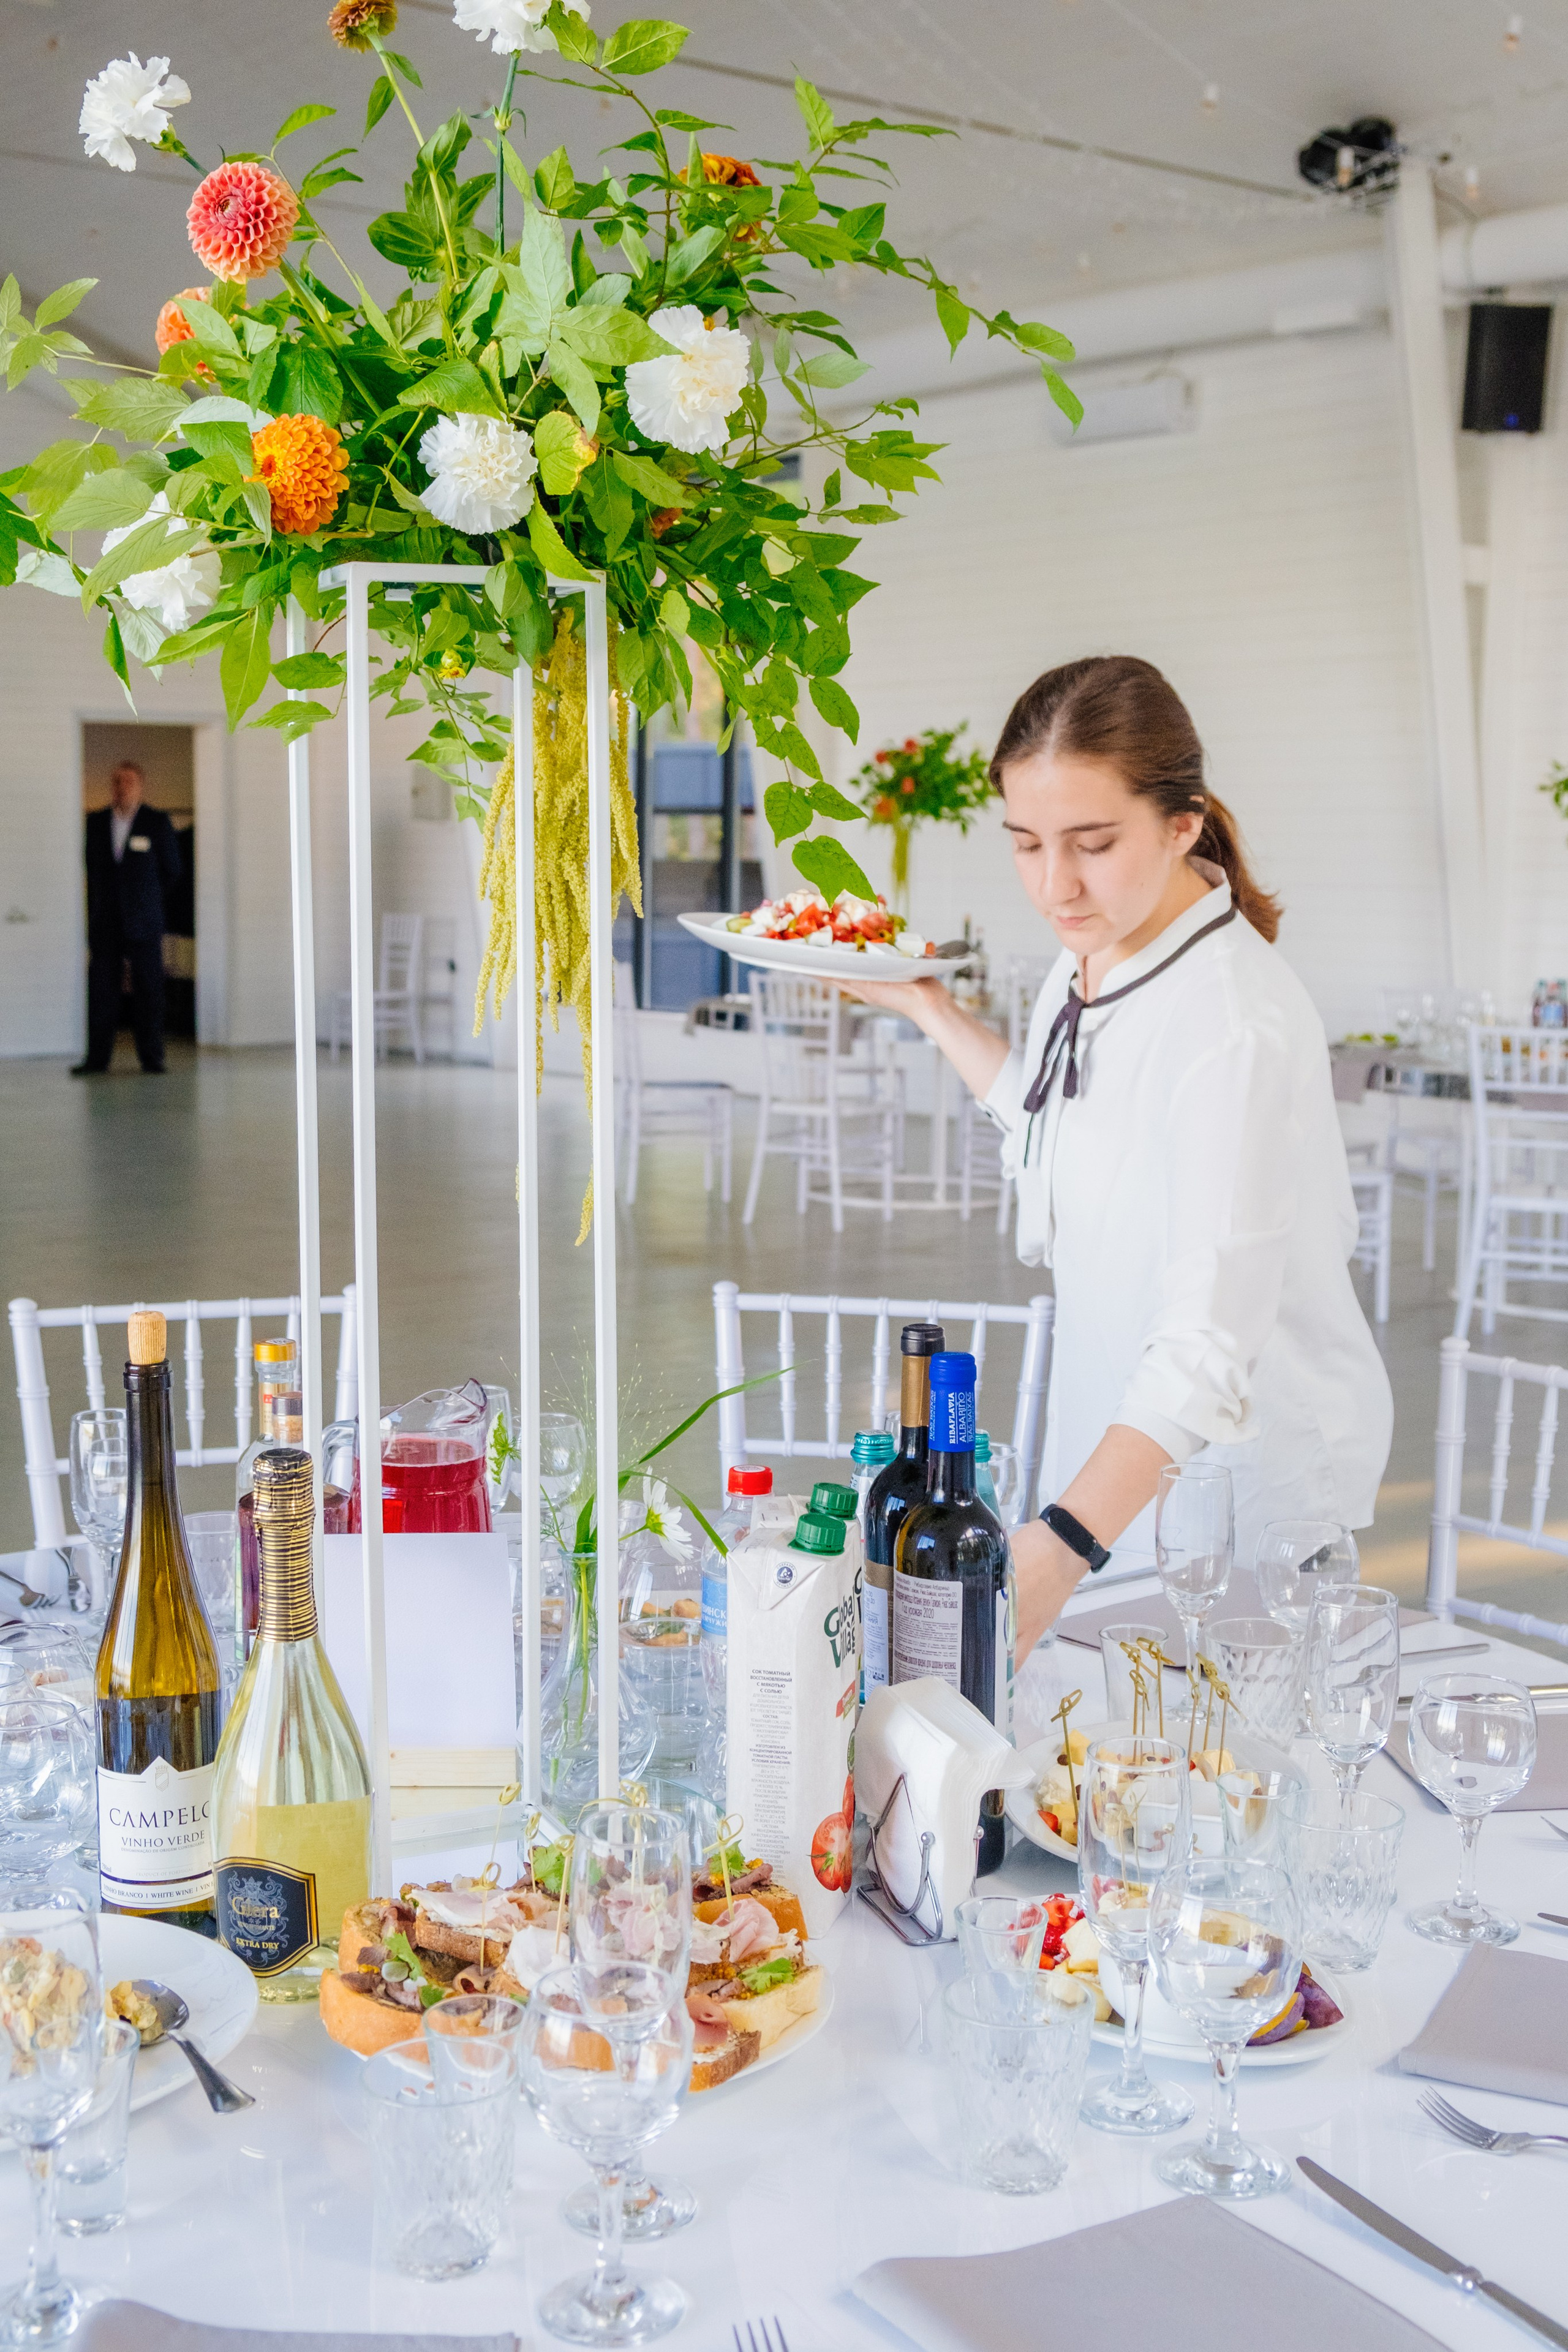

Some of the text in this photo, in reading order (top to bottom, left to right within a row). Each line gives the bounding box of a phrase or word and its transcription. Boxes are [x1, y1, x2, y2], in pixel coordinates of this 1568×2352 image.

[824, 1585, 856, 1638] Global
[923, 1607, 935, 1619] 2020
[122, 1830, 205, 1847] VINHO VERDE
[104, 1884, 117, 1894] VINHO
[118, 1890, 143, 1899] BRANCO
[236, 1937, 280, 1950] EXTRA DRY
